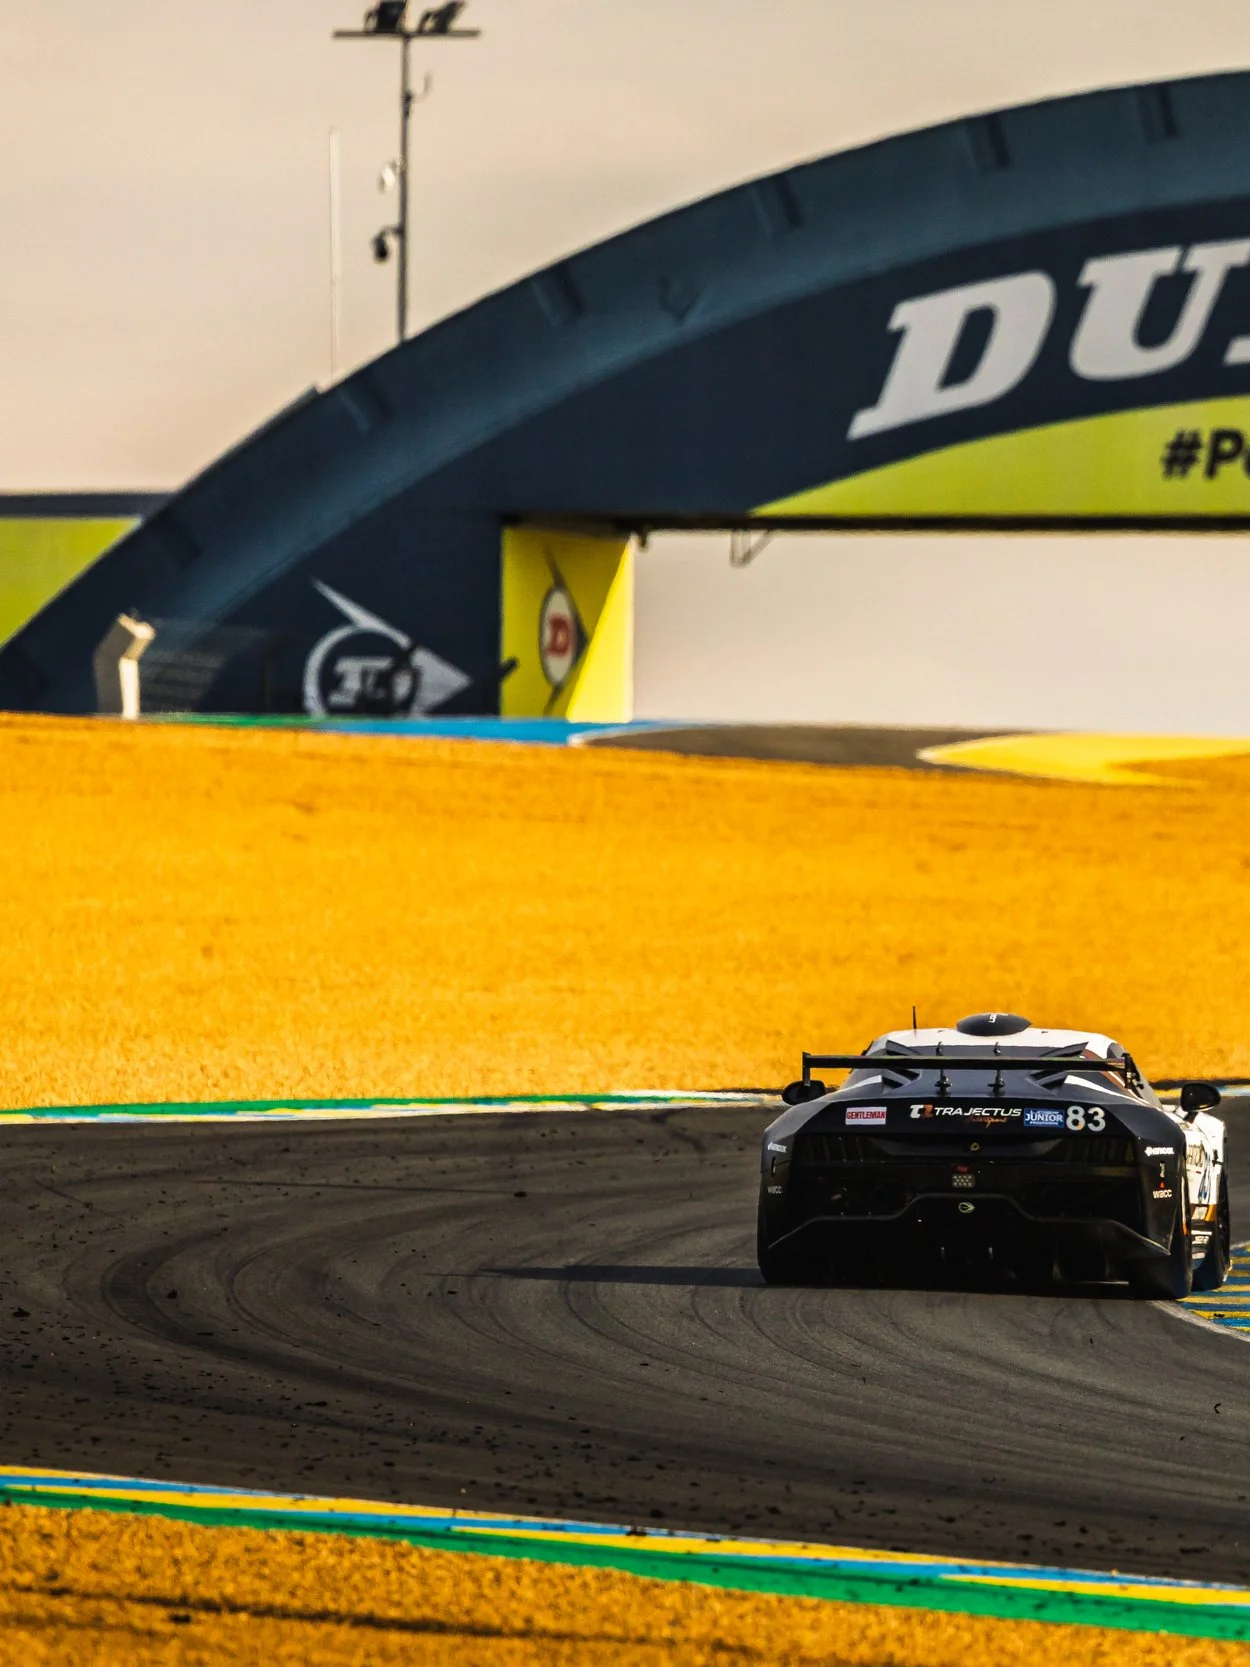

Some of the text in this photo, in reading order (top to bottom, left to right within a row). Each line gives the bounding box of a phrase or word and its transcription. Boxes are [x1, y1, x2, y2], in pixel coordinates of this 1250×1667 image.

[546, 614, 572, 657] D
[846, 1111, 886, 1120] GENTLEMAN
[934, 1107, 1022, 1117] TRAJECTUS
[1024, 1112, 1064, 1122] JUNIOR
[1066, 1105, 1106, 1132] 83
